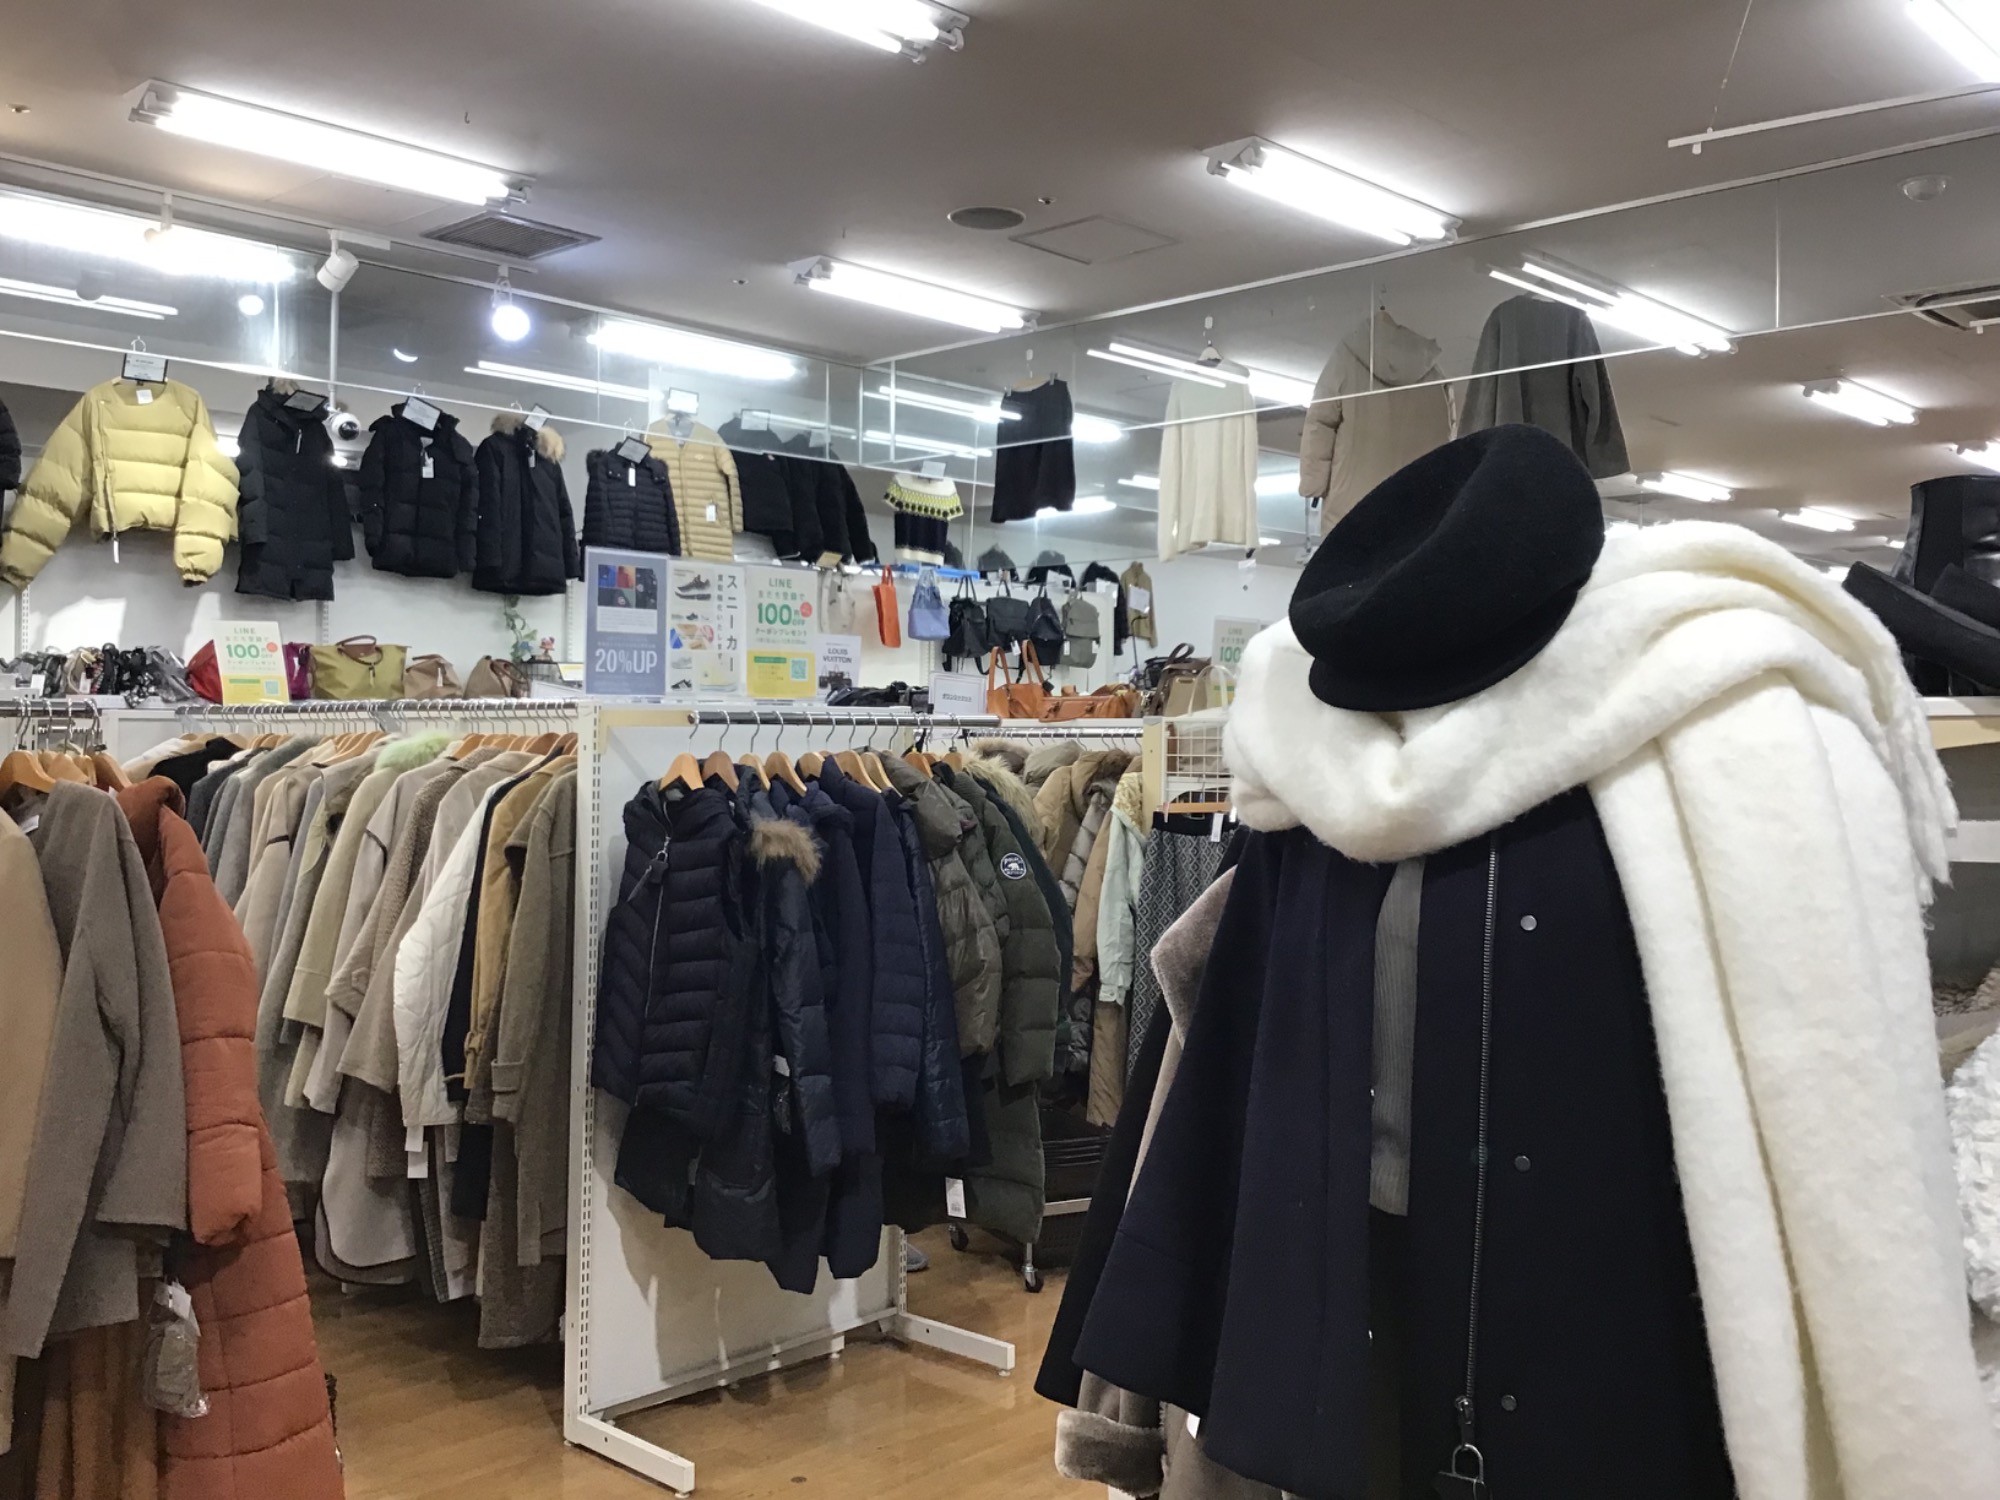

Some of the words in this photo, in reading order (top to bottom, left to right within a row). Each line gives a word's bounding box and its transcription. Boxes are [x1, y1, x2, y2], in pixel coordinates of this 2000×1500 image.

[768, 577, 792, 588] LINE
[757, 602, 792, 625] 100
[727, 575, 738, 672] スニーカー
[226, 644, 260, 658] 100
[828, 647, 849, 656] LOUIS
[1220, 646, 1241, 663] 100
[595, 648, 657, 674] 20%UP
[822, 655, 853, 664] VUITTON
